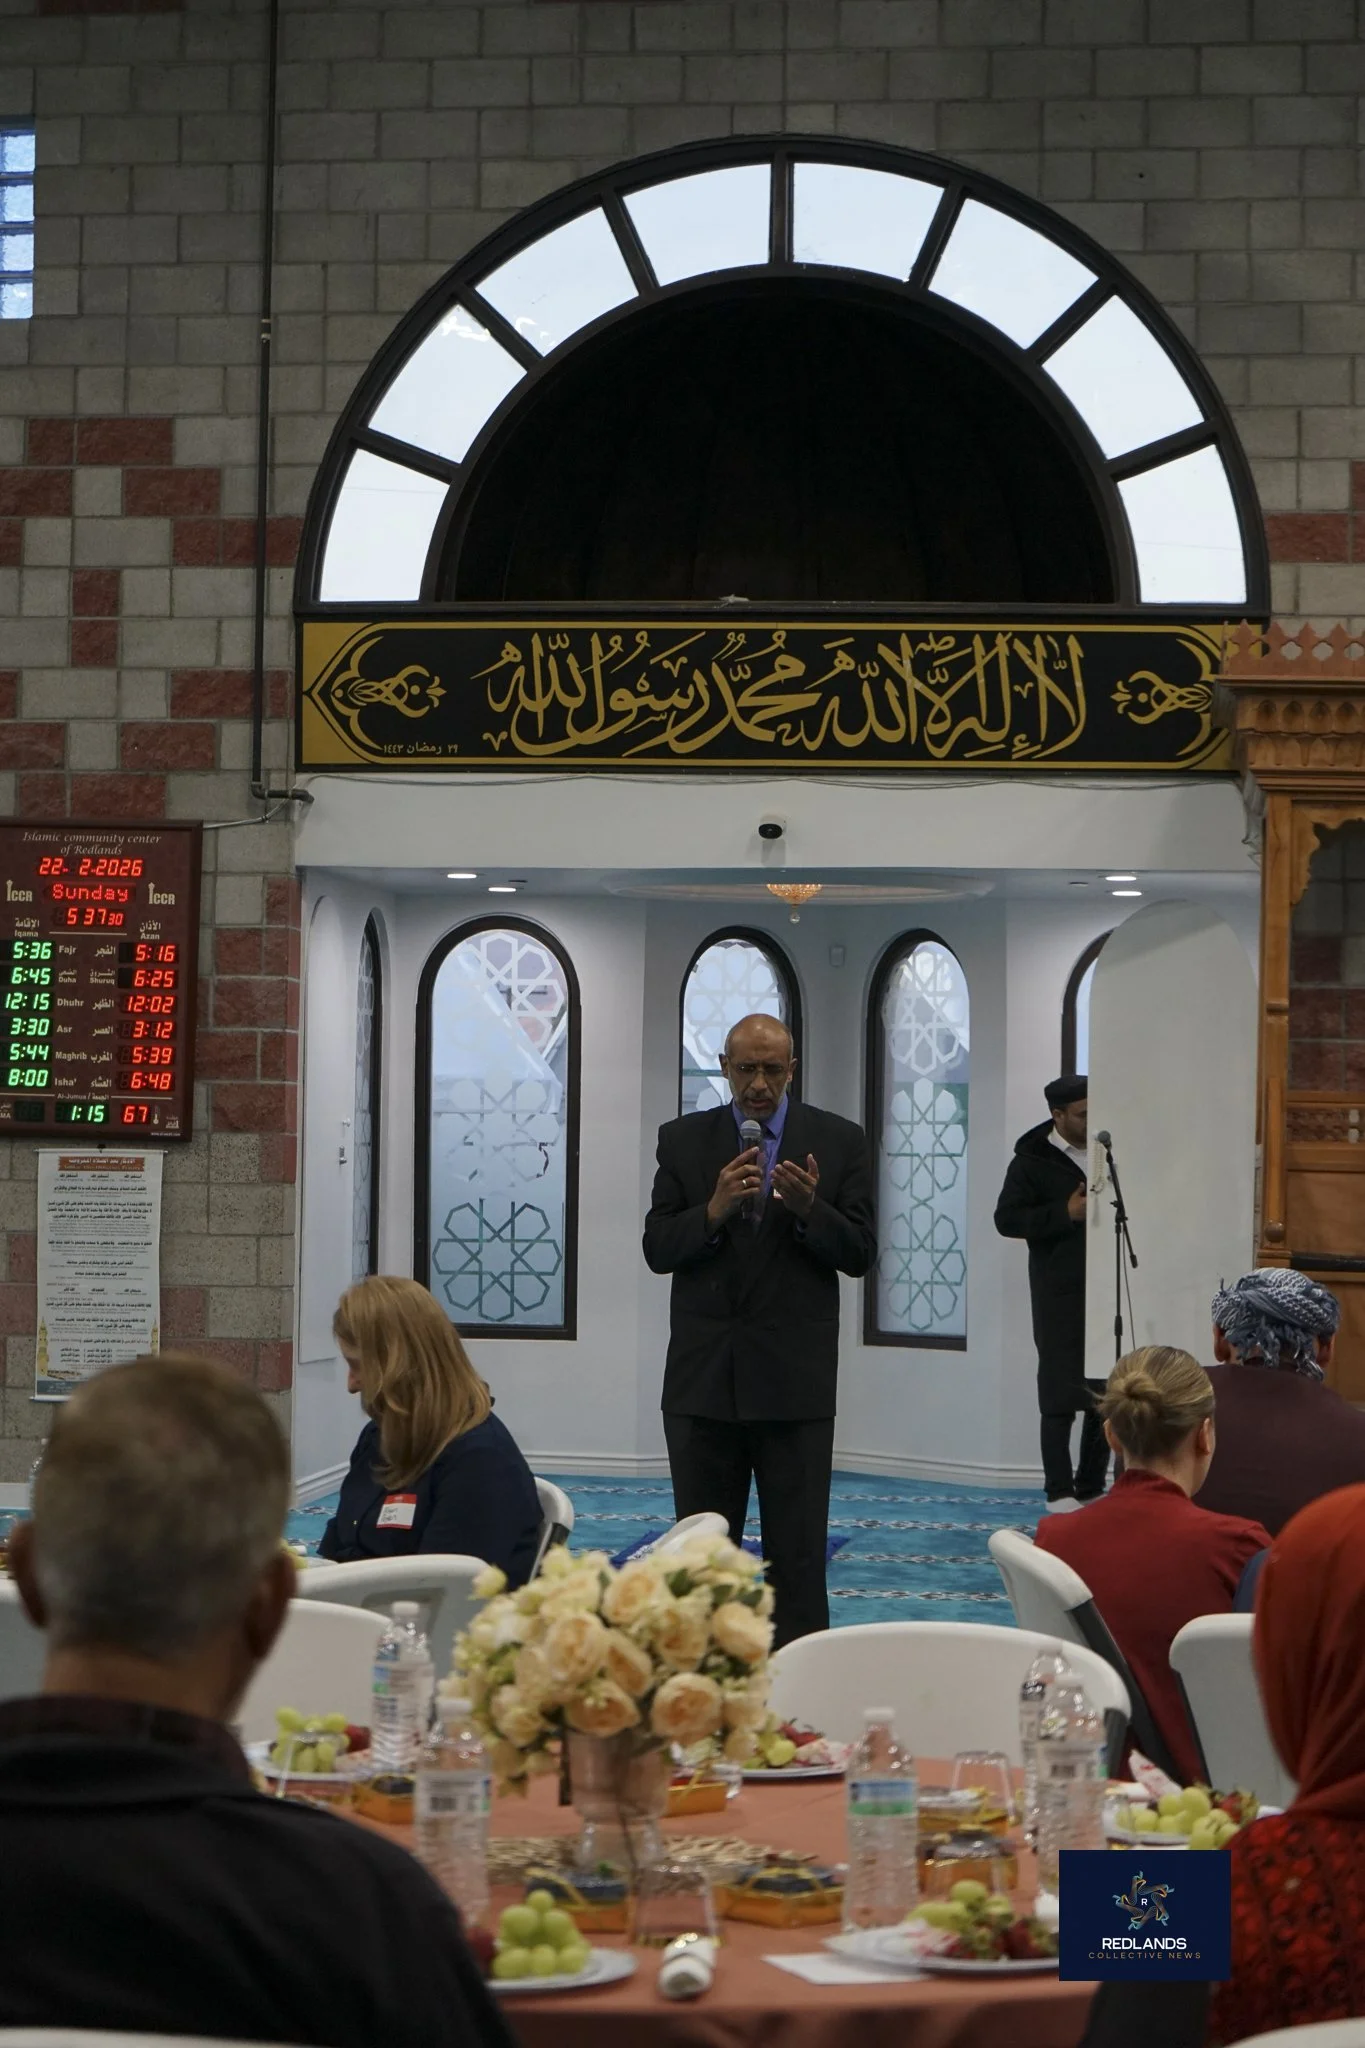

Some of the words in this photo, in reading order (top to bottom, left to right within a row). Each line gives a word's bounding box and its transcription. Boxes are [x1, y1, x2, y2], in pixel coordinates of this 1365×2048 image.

[406, 741, 442, 755] رمضان
[22, 831, 61, 842] Islamic
[64, 832, 124, 845] community
[127, 835, 162, 844] center
[60, 844, 70, 856] of
[73, 844, 122, 856] Redlands
[52, 883, 129, 902] Sunday
[14, 929, 39, 938] Iqama
[140, 932, 160, 941] Azan
[13, 941, 52, 960] 5:36
[58, 945, 77, 955] Fajr
[95, 945, 116, 958] الفجر
[136, 944, 176, 962] 5:16
[11, 966, 51, 985] 6:45
[58, 976, 77, 984] Duha
[89, 977, 115, 986] Shuruq
[134, 970, 174, 988] 6:25
[5, 992, 50, 1010] 12:15
[57, 998, 85, 1007] Dhuhr
[92, 998, 115, 1011] الظهر
[127, 995, 174, 1013] 12:02
[10, 1017, 50, 1036] 3:30
[56, 1025, 73, 1033] Asr
[92, 1025, 114, 1037] العصر
[133, 1020, 173, 1039] 3:12
[9, 1043, 49, 1061] 5:44
[55, 1051, 88, 1062] Maghrib
[132, 1046, 173, 1064] 5:39
[8, 1068, 49, 1087] 8:00
[131, 1072, 172, 1090] 6:48
[71, 1105, 105, 1122] 1:15
[123, 1106, 149, 1123] 67
